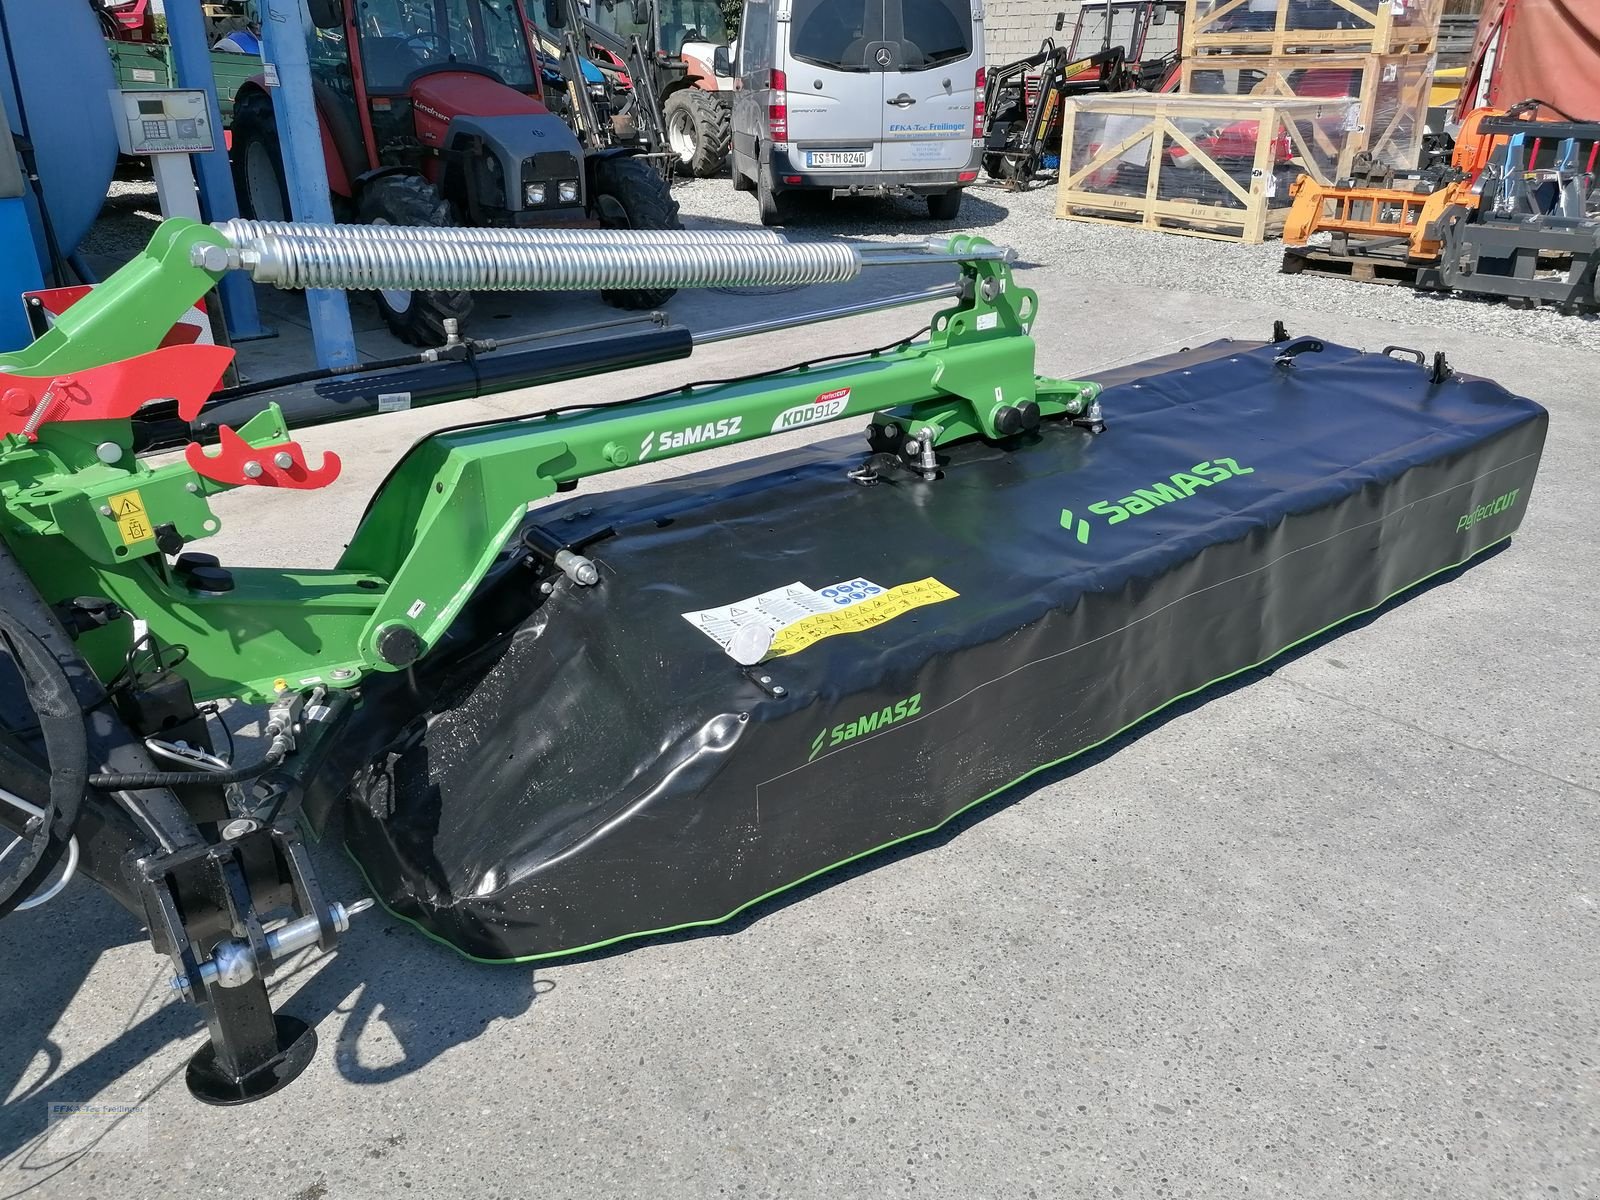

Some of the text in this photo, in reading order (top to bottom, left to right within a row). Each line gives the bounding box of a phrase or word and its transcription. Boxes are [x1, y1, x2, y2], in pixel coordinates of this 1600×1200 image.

[415, 100, 450, 121] Lindner
[890, 122, 965, 132] EFKA-Tec Freilinger
[813, 153, 865, 164] TS TM 8240
[782, 401, 840, 427] KDD912
[659, 416, 743, 451] SaMASZ
[1088, 457, 1254, 525] SaMASZ
[829, 692, 921, 747] SaMASZ
